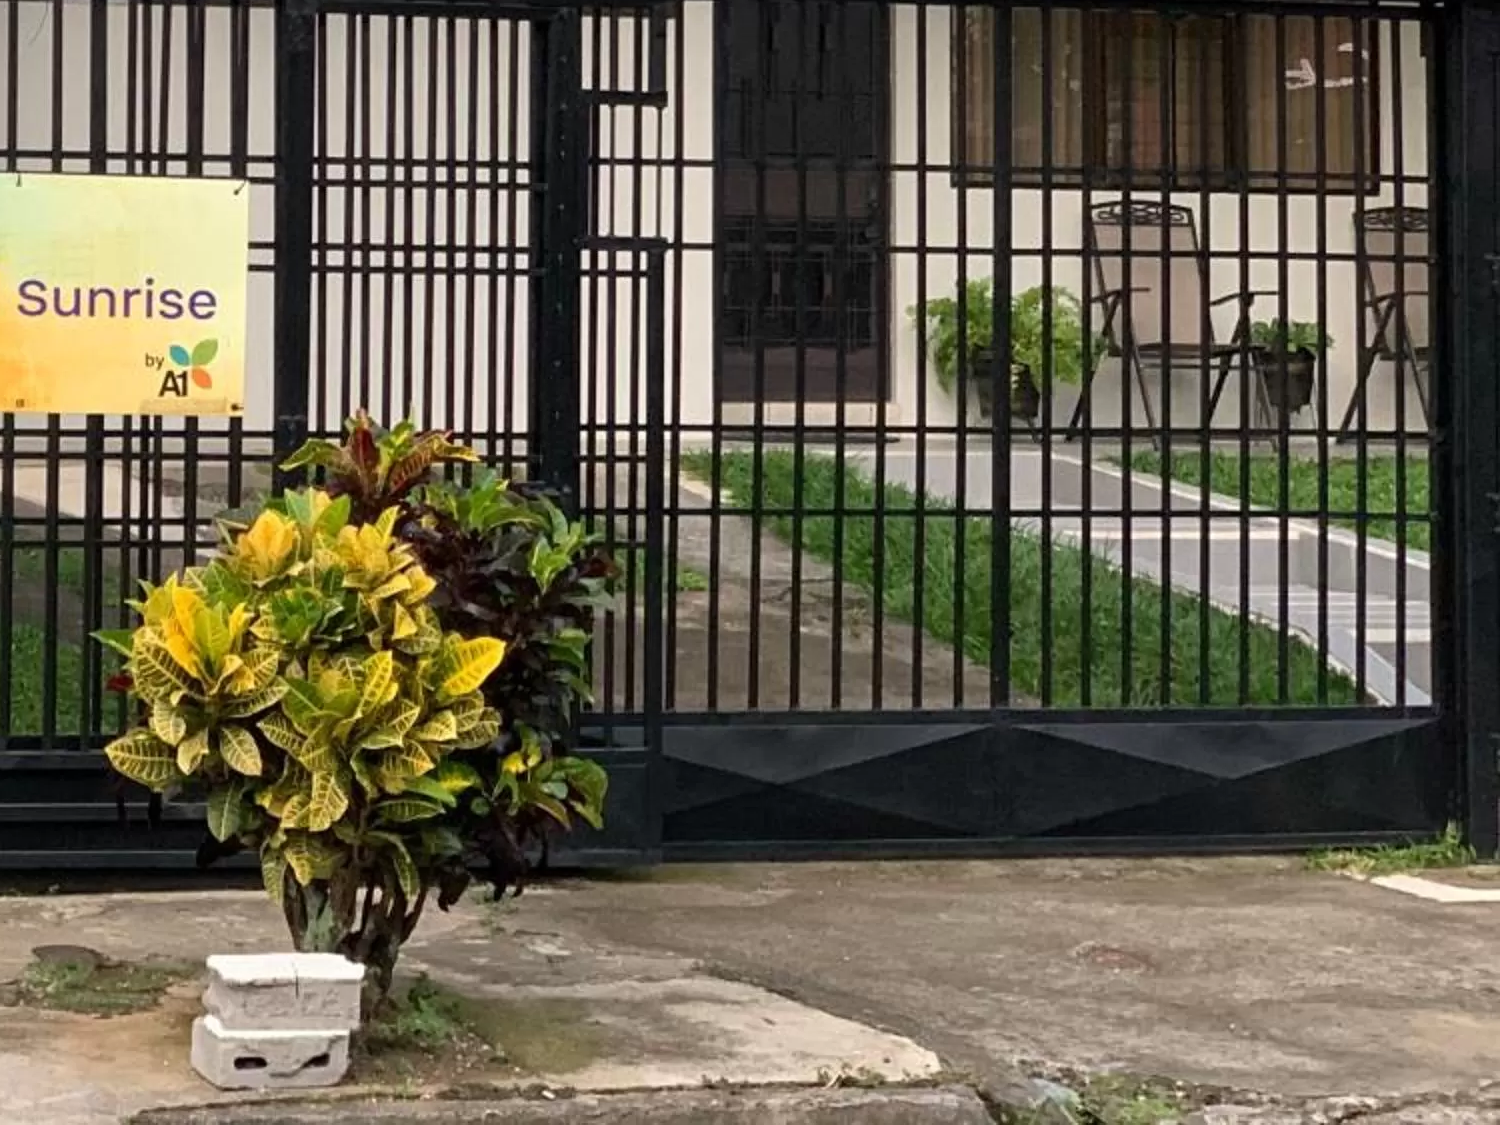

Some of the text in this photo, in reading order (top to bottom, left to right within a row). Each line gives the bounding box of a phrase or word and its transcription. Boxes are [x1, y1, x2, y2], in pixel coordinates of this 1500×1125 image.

[17, 278, 218, 320] Sunrise
[144, 352, 165, 371] by
[157, 370, 189, 398] A1
